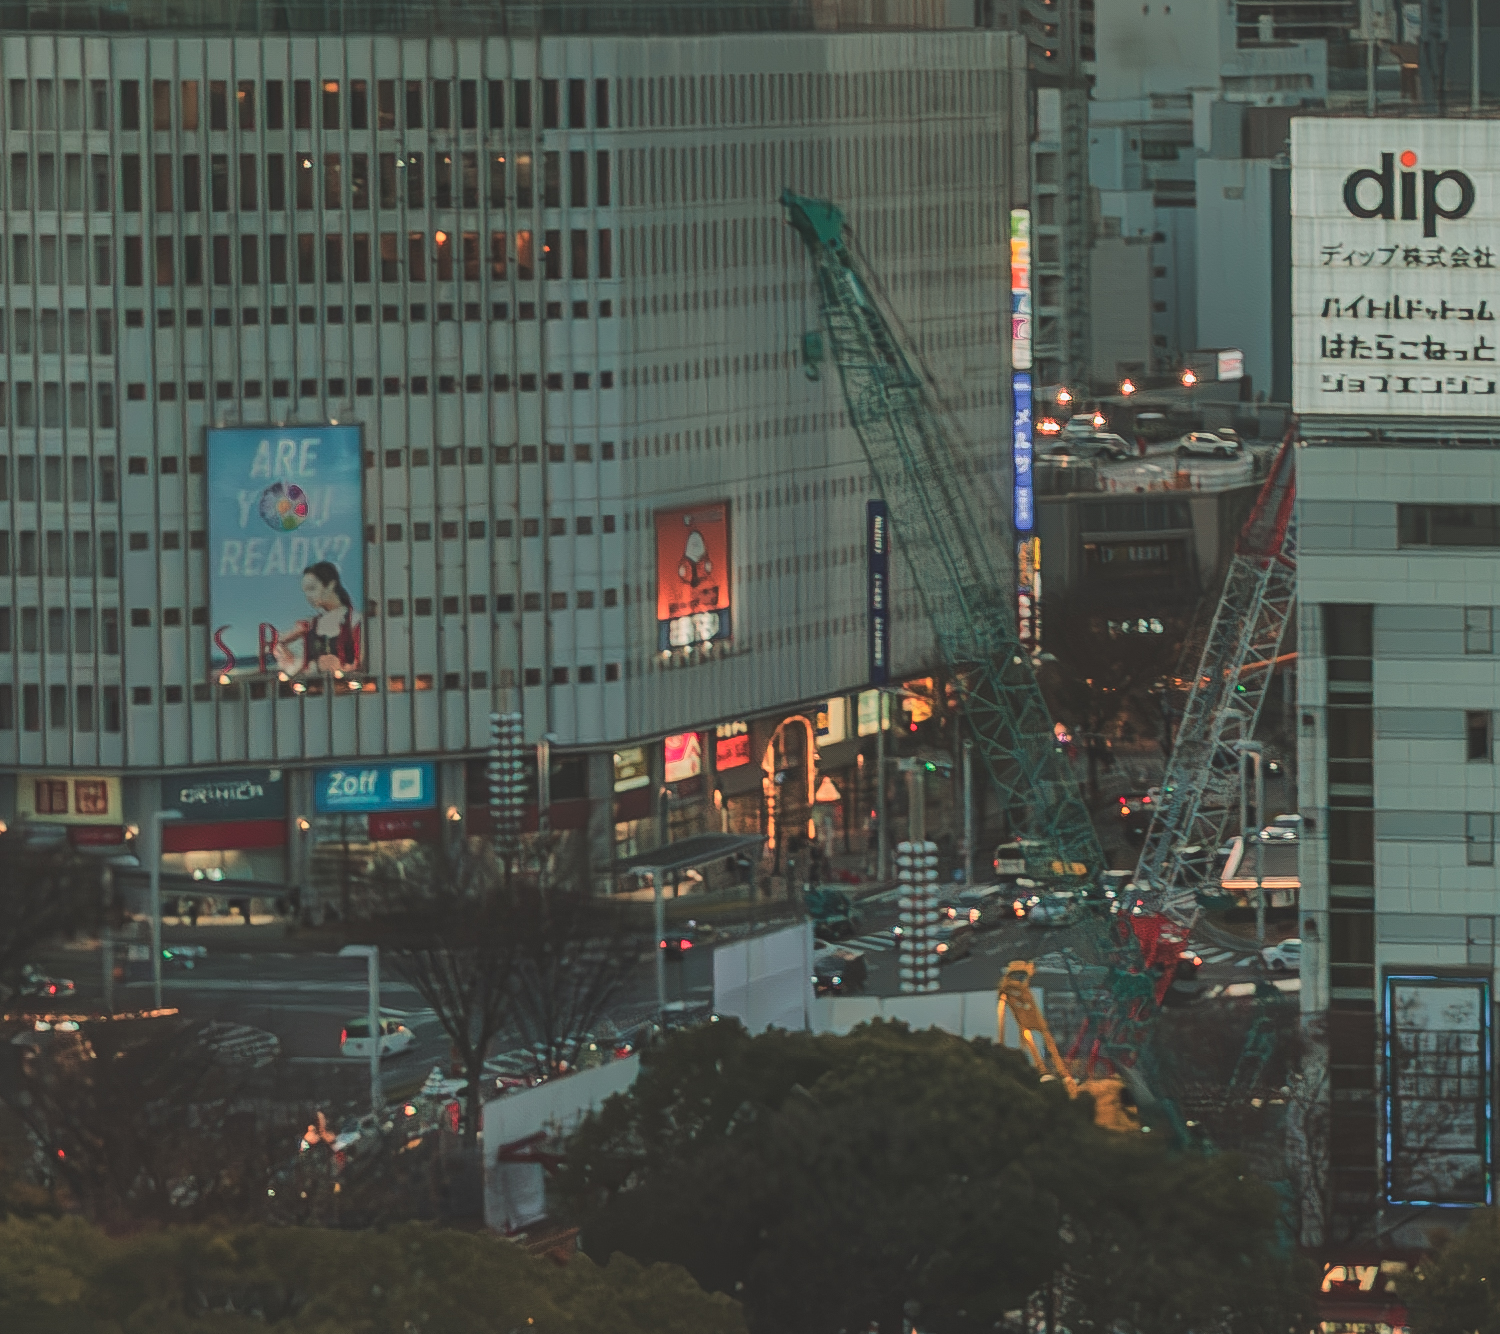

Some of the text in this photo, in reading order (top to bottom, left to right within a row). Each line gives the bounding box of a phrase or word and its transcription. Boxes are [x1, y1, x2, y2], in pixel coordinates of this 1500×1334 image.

[1343, 150, 1475, 238] dip
[1320, 243, 1497, 268] ディップ株式会社
[1320, 294, 1496, 321] バイトルドットコム
[1320, 333, 1496, 362] はたらこねっと
[1321, 373, 1496, 395] ジョブエンジン
[251, 438, 321, 478] ARE
[327, 769, 380, 796] Zoff
